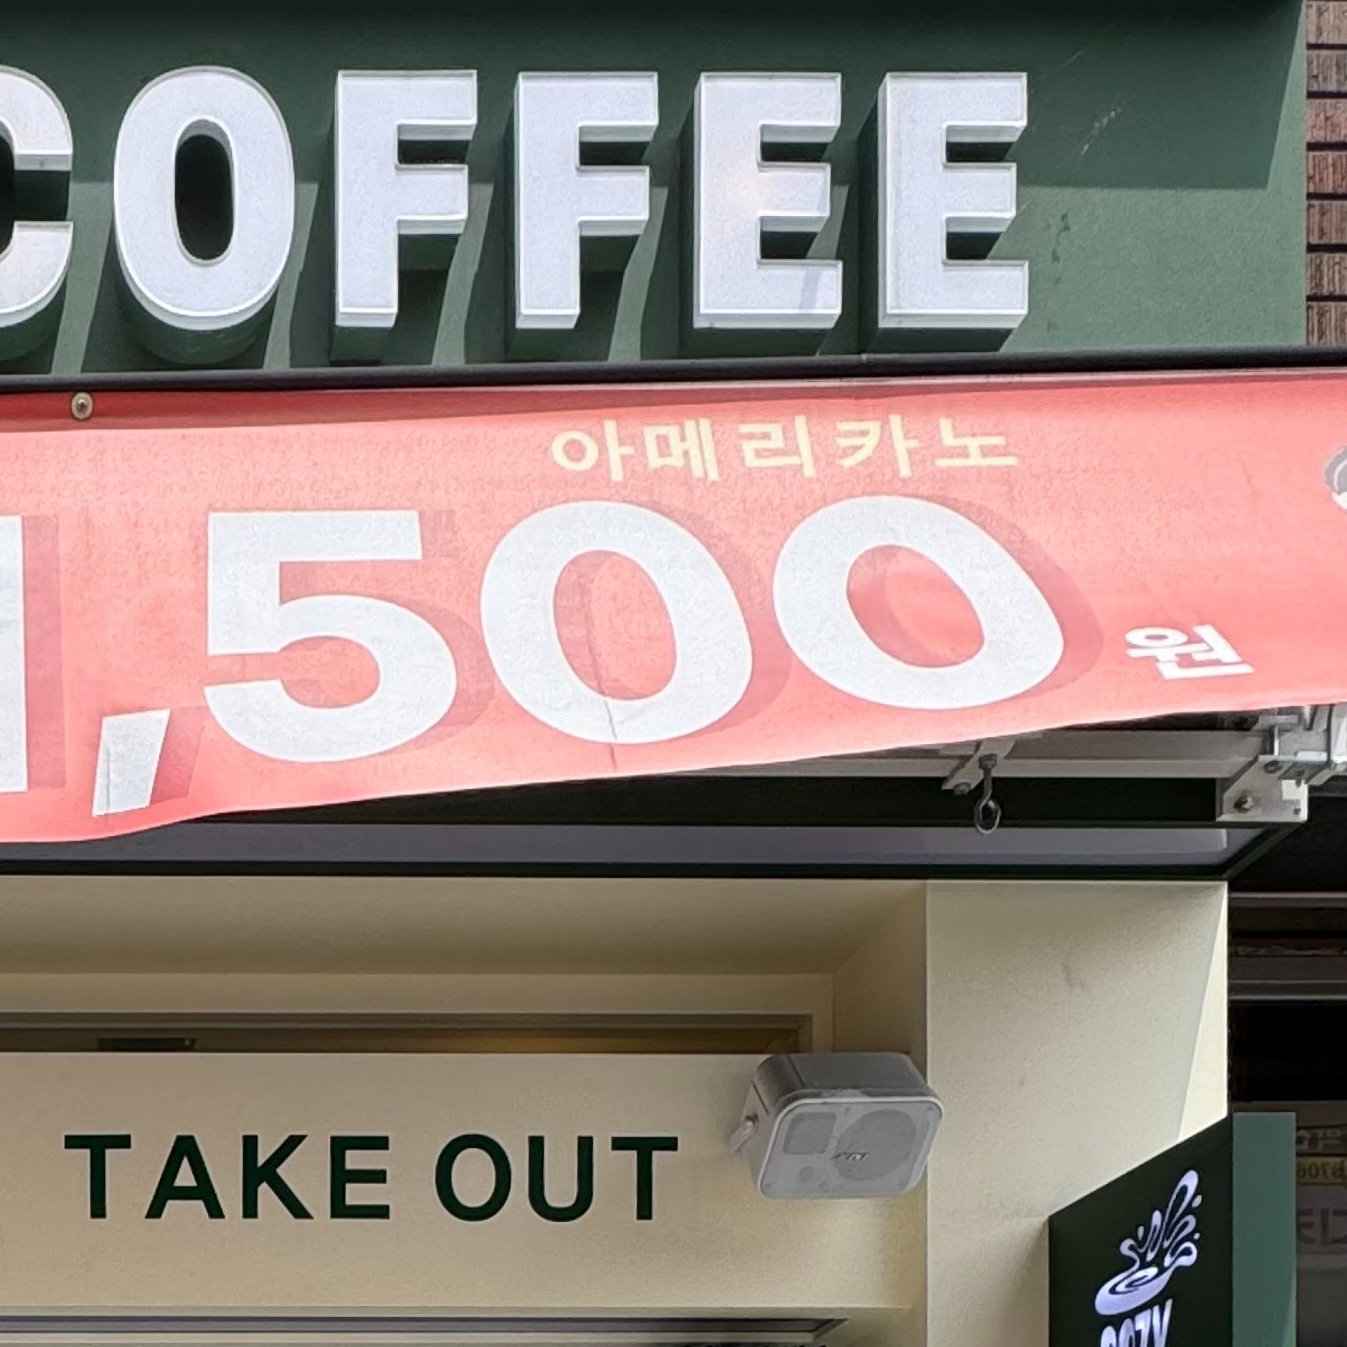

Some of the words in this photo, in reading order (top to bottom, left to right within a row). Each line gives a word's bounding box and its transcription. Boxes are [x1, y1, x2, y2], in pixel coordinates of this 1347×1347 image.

[550, 416, 1019, 484] 아메리카노
[1124, 621, 1254, 681] 원
[64, 1134, 390, 1222] TAKE
[434, 1134, 679, 1223] OUT
